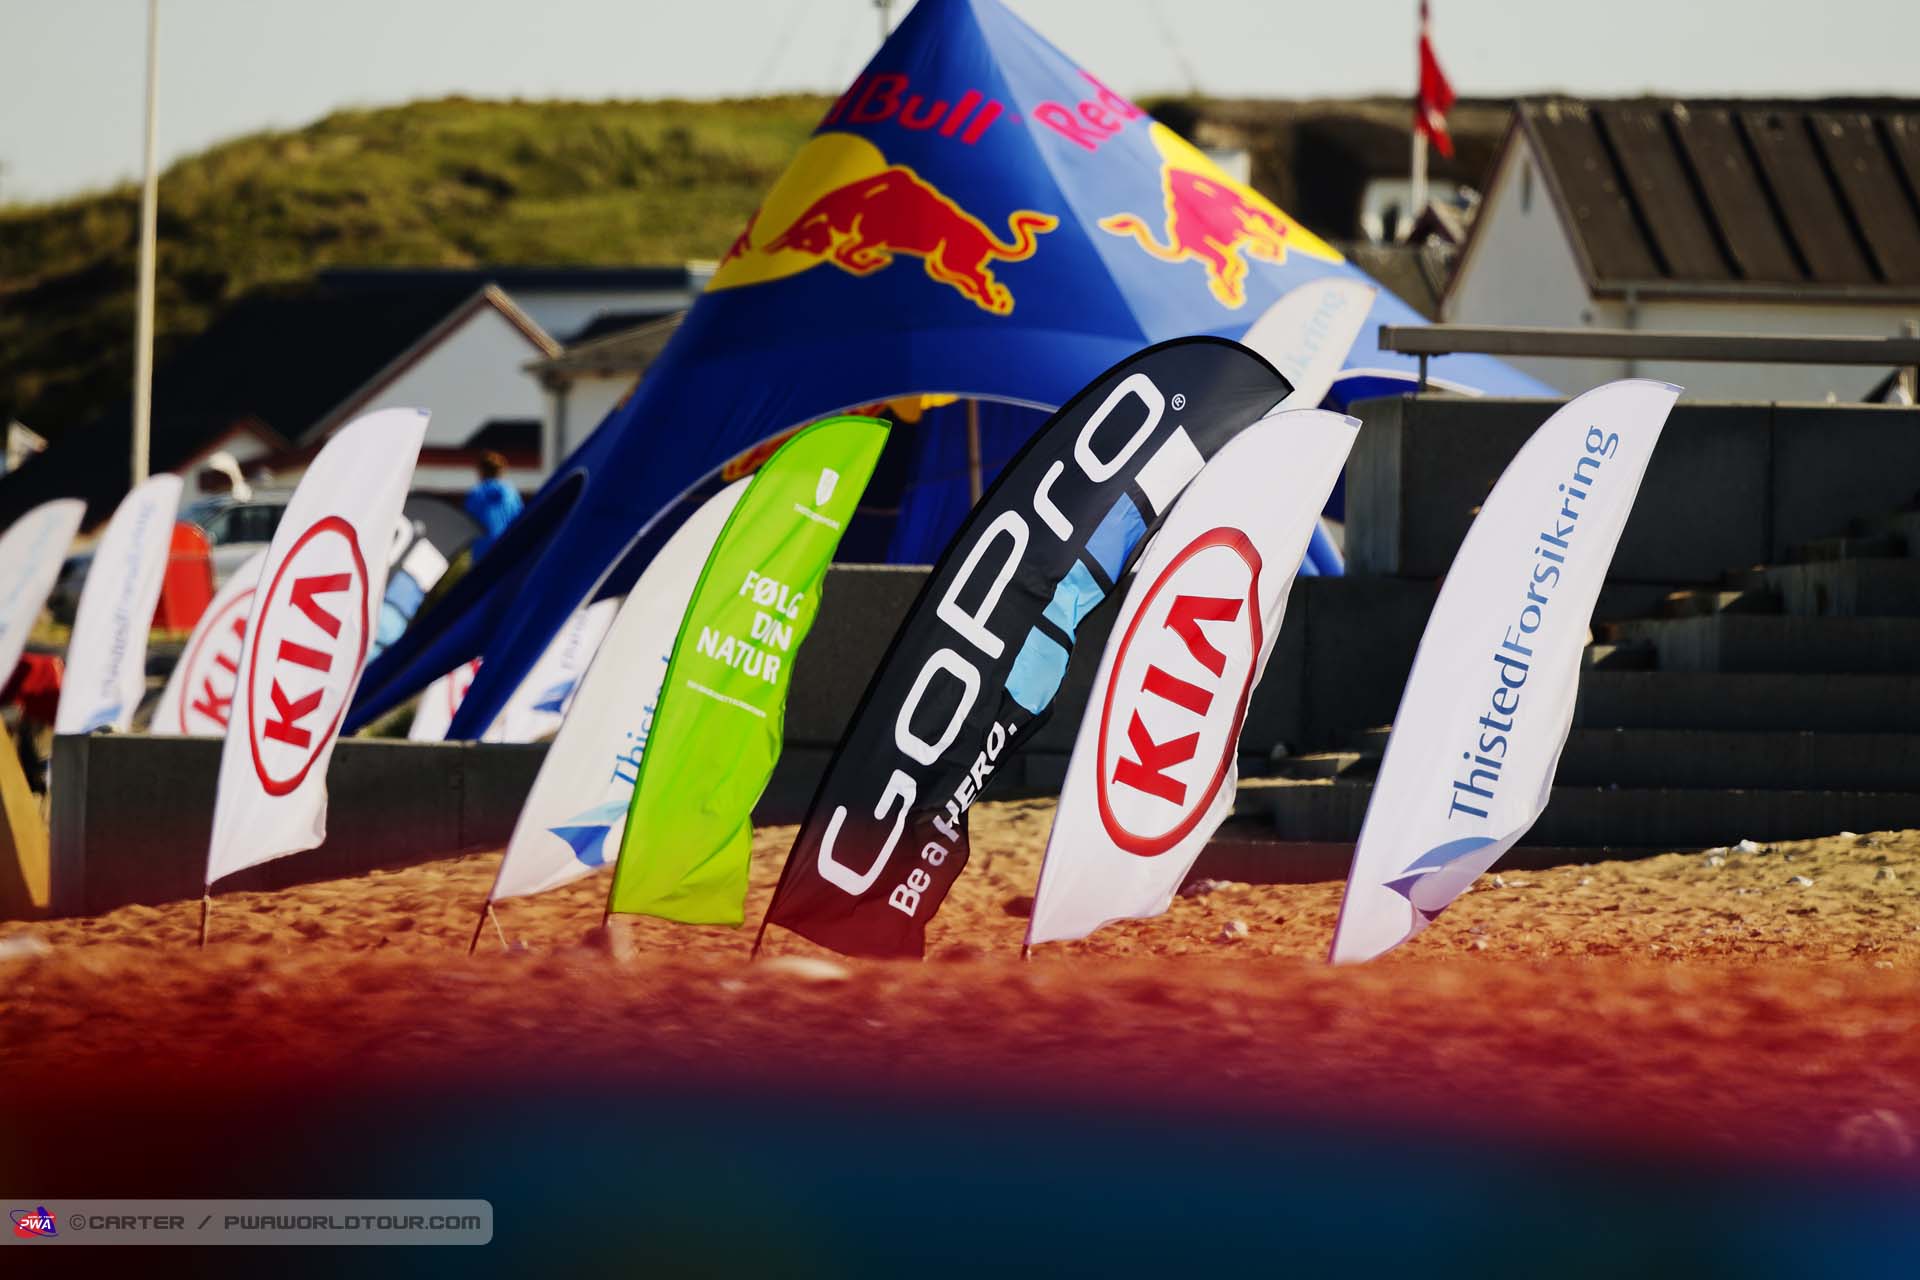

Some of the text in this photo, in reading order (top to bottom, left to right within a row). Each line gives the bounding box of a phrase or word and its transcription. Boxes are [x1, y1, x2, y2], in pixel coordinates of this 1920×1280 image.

[847, 73, 1004, 146] Bull
[696, 625, 781, 685] NATUR
[750, 611, 793, 652] DIN
[1449, 425, 1620, 819] ThistedForsikring
[262, 572, 353, 750] KIA
[1110, 593, 1244, 808] KIA
[888, 868, 931, 917] Be
[921, 841, 948, 866] a
